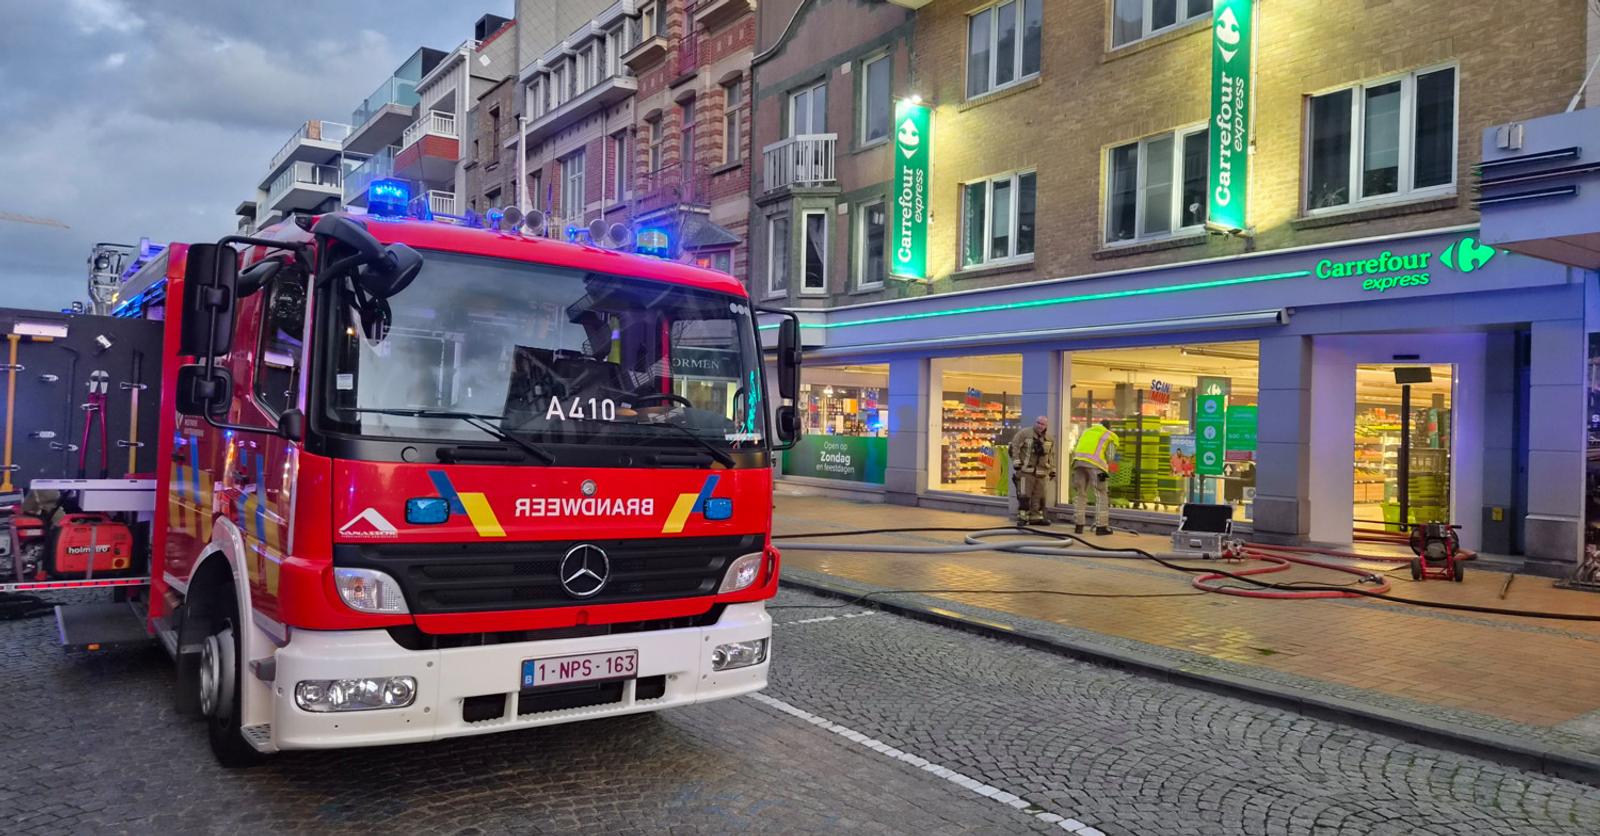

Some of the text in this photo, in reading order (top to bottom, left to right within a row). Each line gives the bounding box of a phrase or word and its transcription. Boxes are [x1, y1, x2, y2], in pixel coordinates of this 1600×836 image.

[1234, 76, 1244, 152] express
[1215, 72, 1233, 207] Carrefour
[914, 168, 924, 224] express
[898, 165, 914, 263] Carrefour
[1315, 250, 1432, 280] Carrefour
[1362, 272, 1431, 292] express
[823, 441, 848, 451] Open op
[816, 463, 855, 474] en feestdagen
[820, 451, 851, 466] Zondag
[68, 545, 109, 554] holmtro
[524, 675, 532, 684] B
